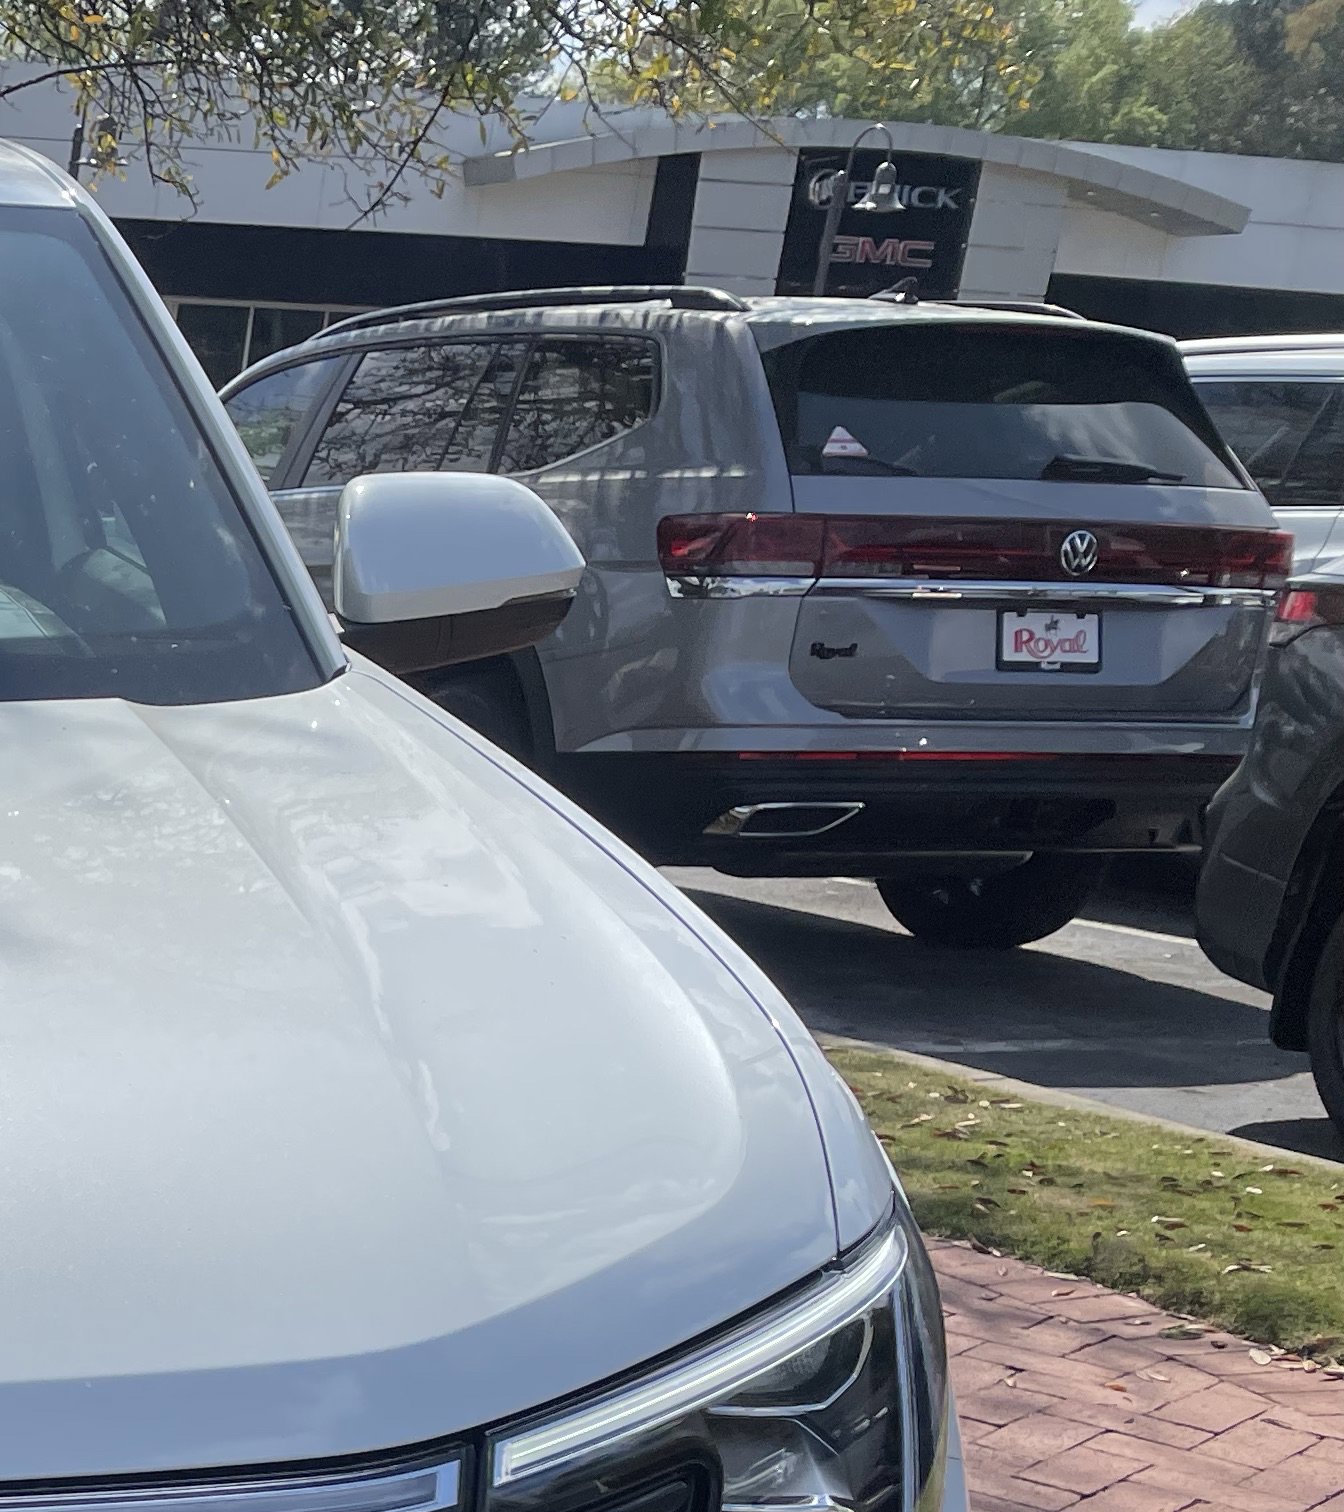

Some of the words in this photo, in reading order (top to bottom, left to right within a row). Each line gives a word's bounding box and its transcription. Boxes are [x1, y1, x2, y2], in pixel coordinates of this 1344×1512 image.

[847, 180, 961, 209] BICK
[830, 235, 935, 268] GMC
[1014, 628, 1089, 660] Royal
